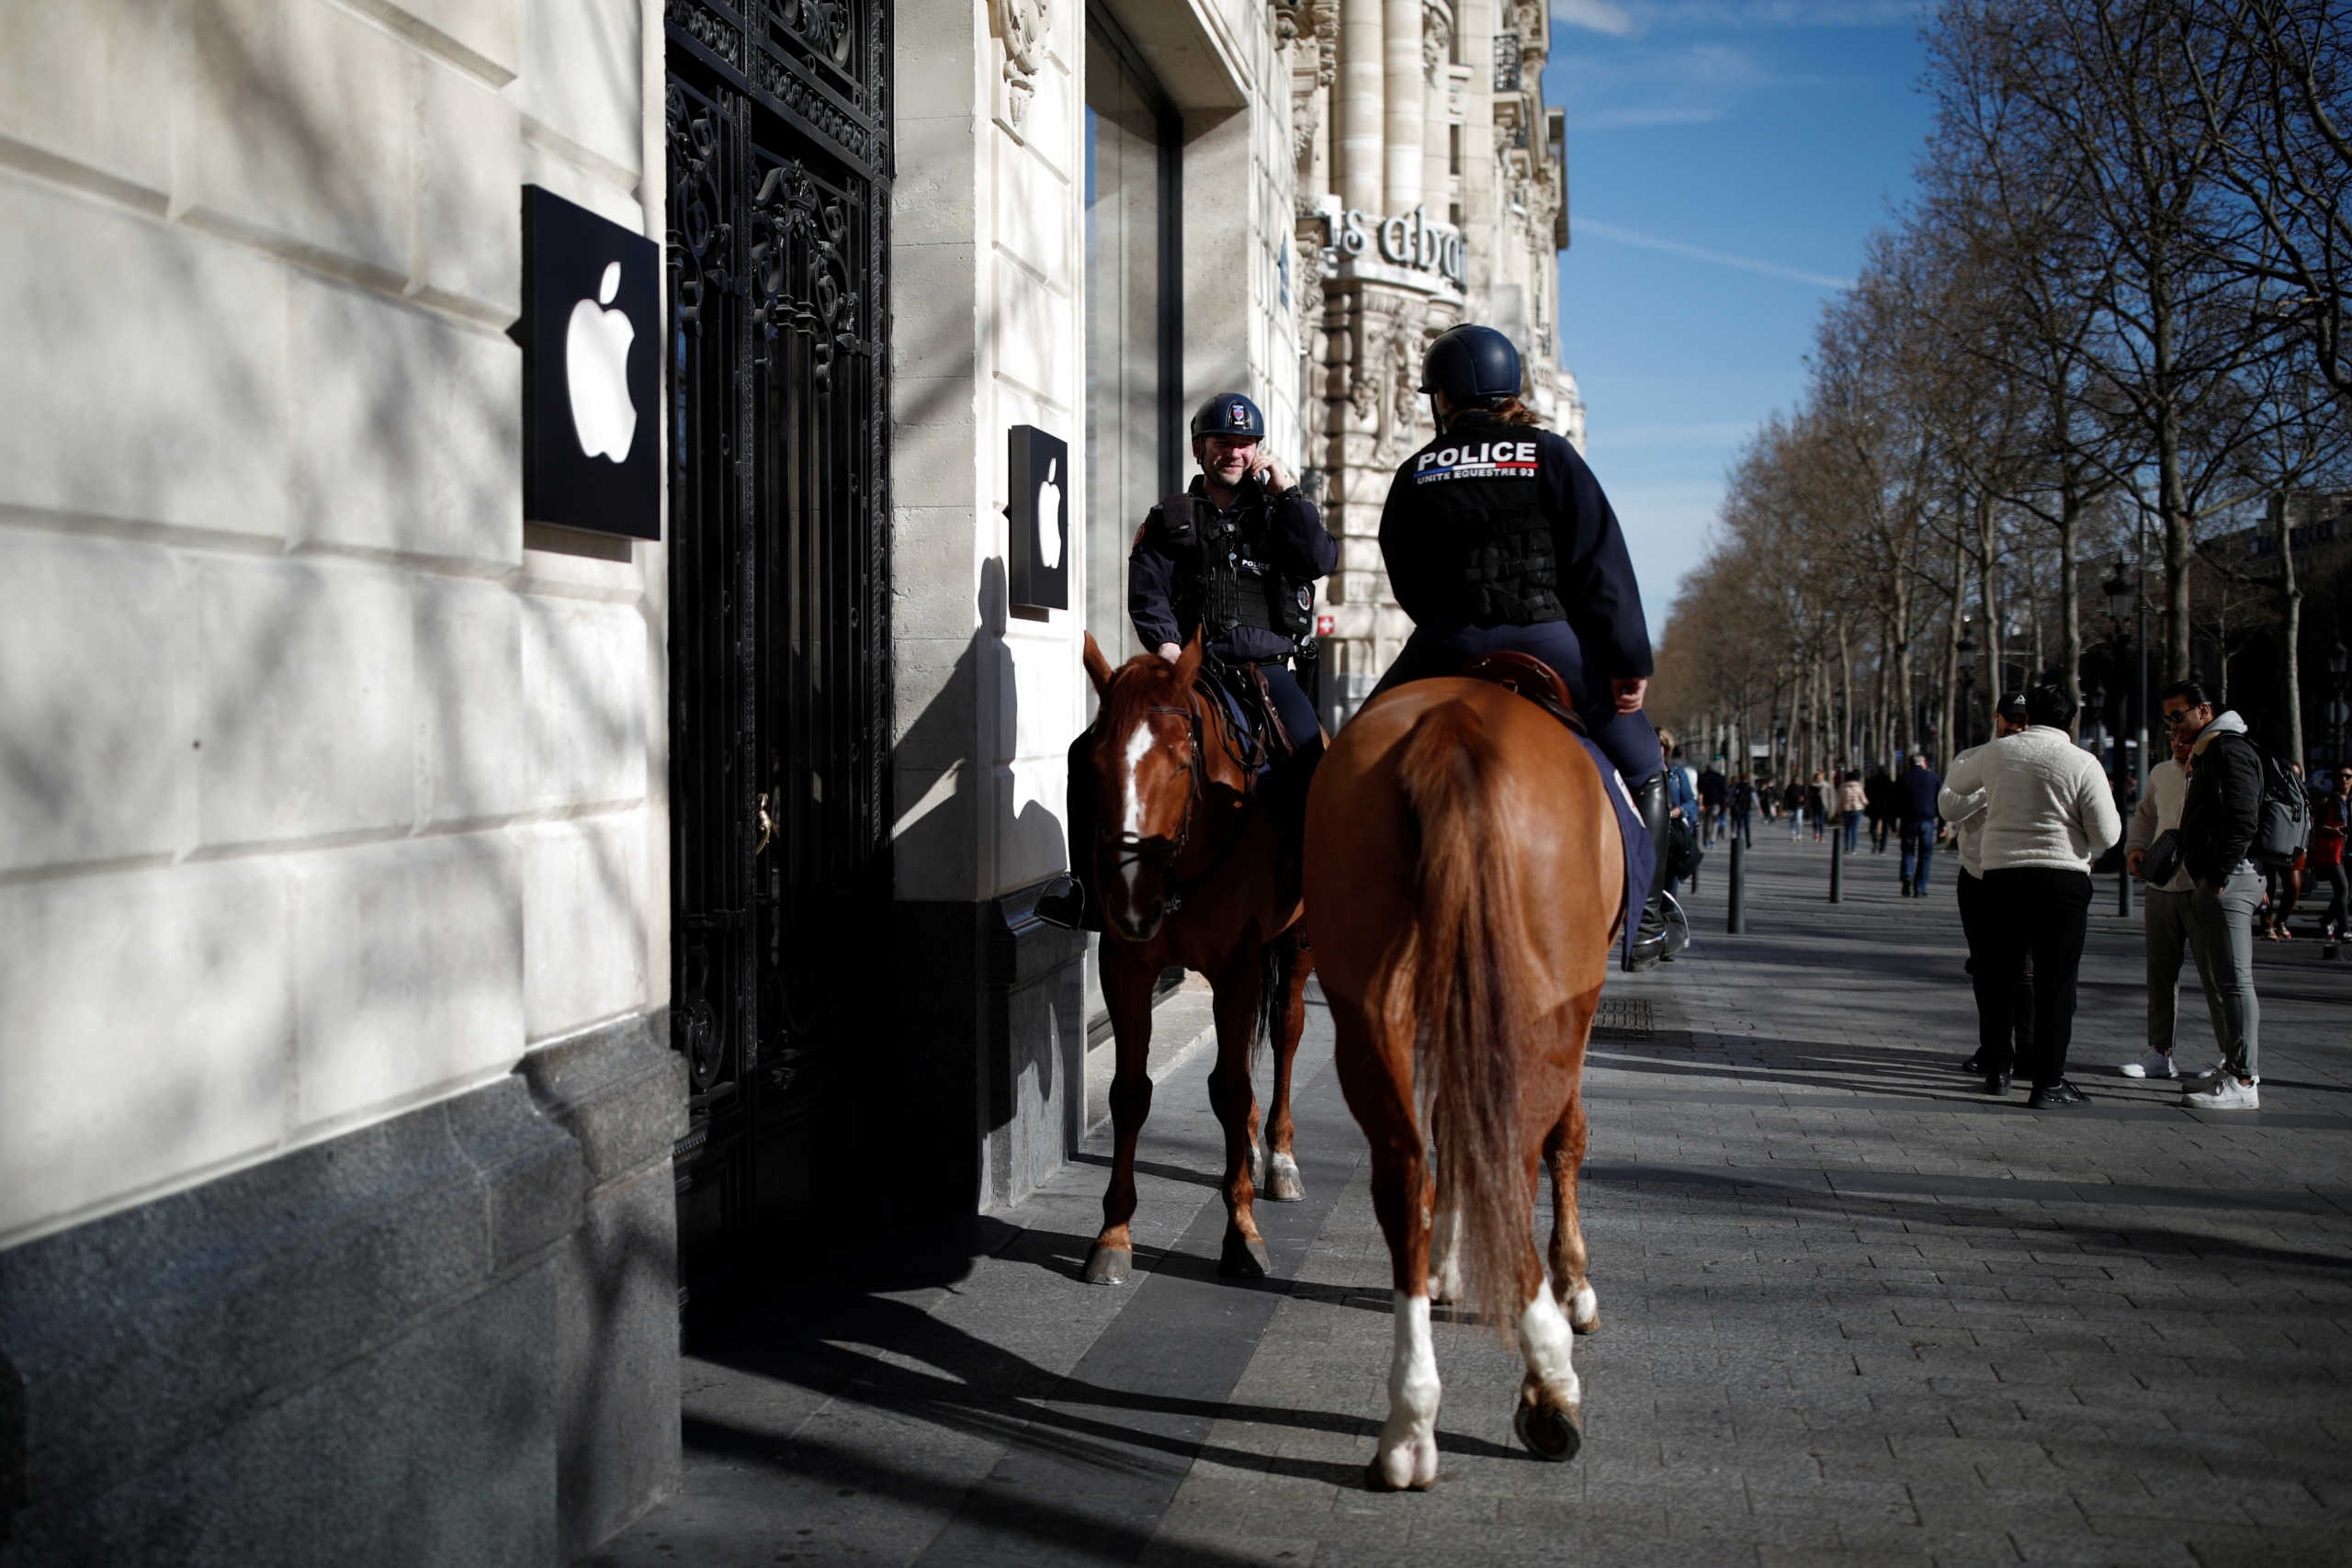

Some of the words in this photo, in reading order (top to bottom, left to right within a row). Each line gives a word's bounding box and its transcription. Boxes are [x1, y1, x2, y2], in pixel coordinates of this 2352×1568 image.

[1418, 442, 1536, 471] POLICE
[1417, 471, 1452, 485] UNITE
[1454, 468, 1517, 479] EQUESTRE
[1520, 468, 1535, 478] 93
